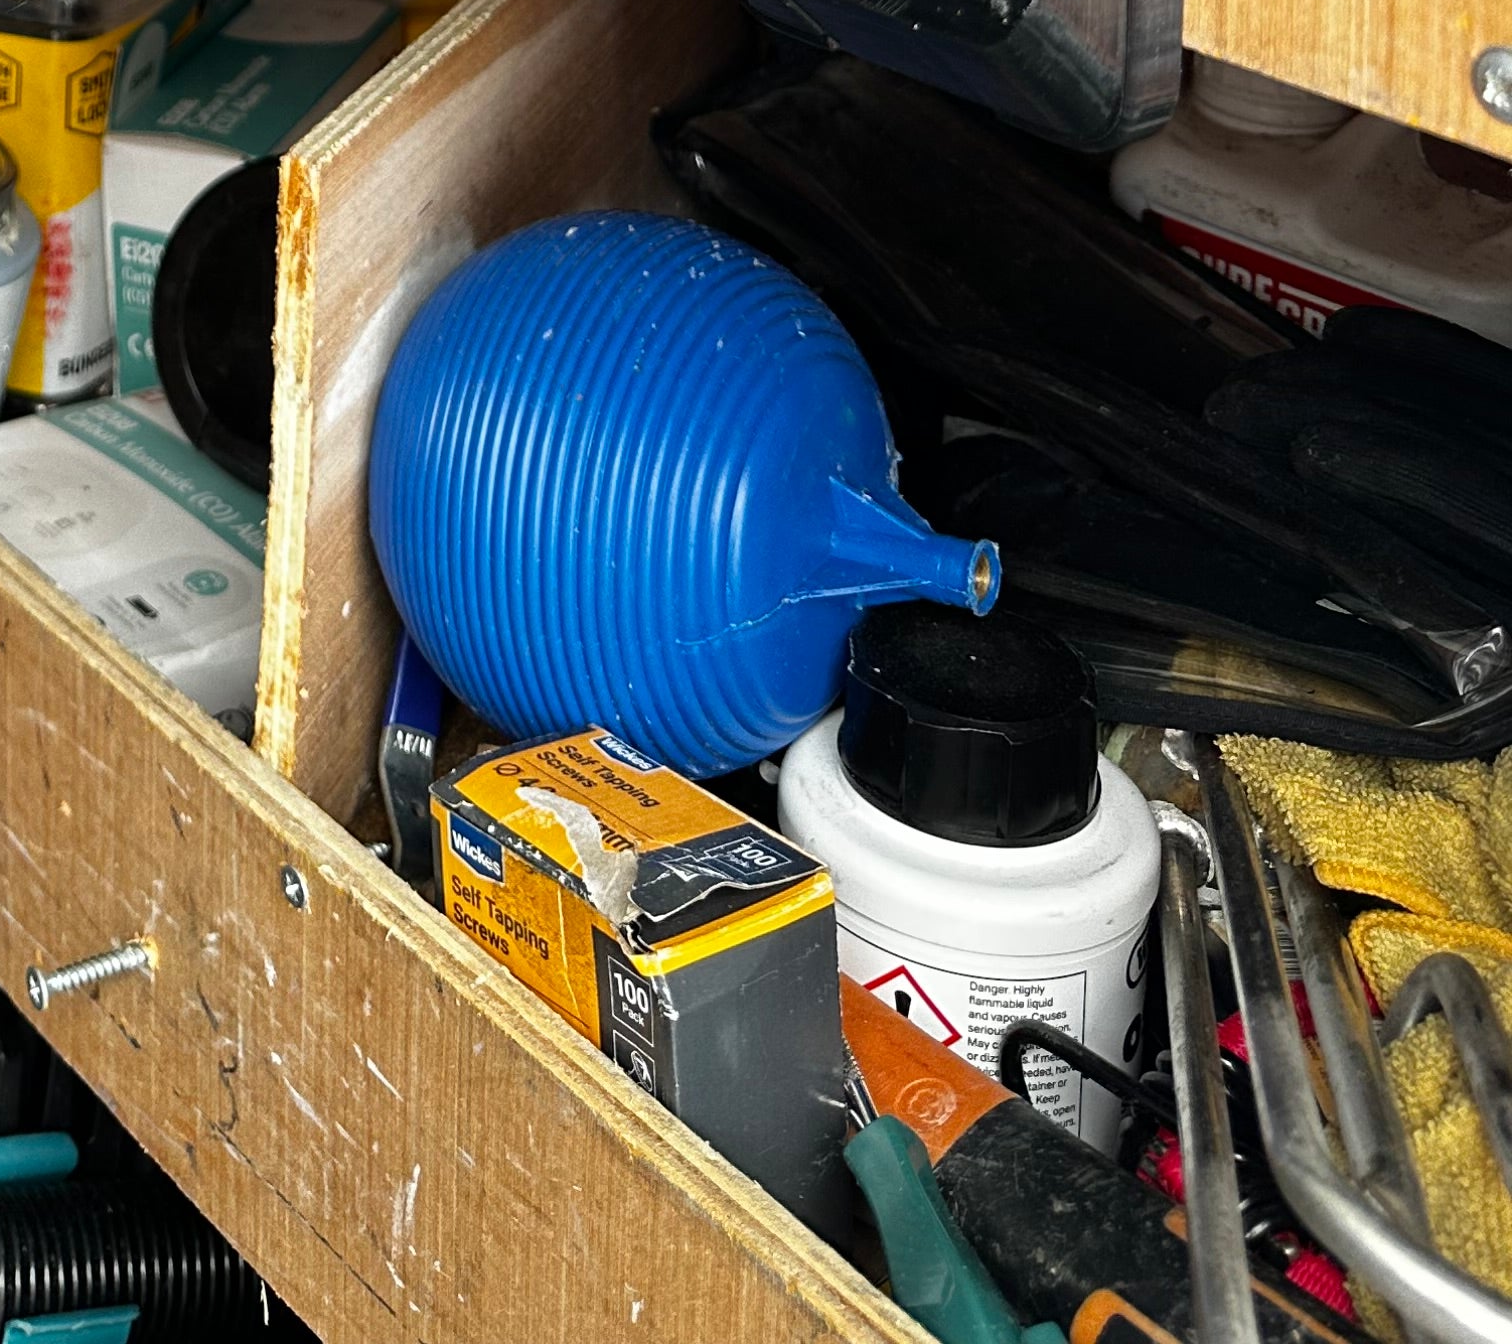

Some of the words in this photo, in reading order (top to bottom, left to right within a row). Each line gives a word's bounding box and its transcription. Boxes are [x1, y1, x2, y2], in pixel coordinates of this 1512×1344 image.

[600, 736, 654, 771] Wickes
[537, 750, 598, 789] Screws
[557, 744, 600, 768] Self
[593, 758, 661, 809] Tapping
[451, 829, 502, 878] Wickes
[731, 842, 778, 867] 100
[451, 873, 482, 909] Self
[484, 895, 550, 961] Tapping
[452, 901, 510, 956] Screws
[613, 972, 650, 1007] 100
[1013, 985, 1046, 997] Highly
[620, 1001, 646, 1027] Pack
[968, 995, 1025, 1009] flammable
[1026, 997, 1054, 1010] liquid
[968, 1010, 989, 1021] and
[967, 1023, 1006, 1036] serious
[967, 1037, 990, 1050] May
[966, 1052, 979, 1061] or
[1035, 1093, 1061, 1105] Keep
[1052, 1103, 1076, 1117] open
